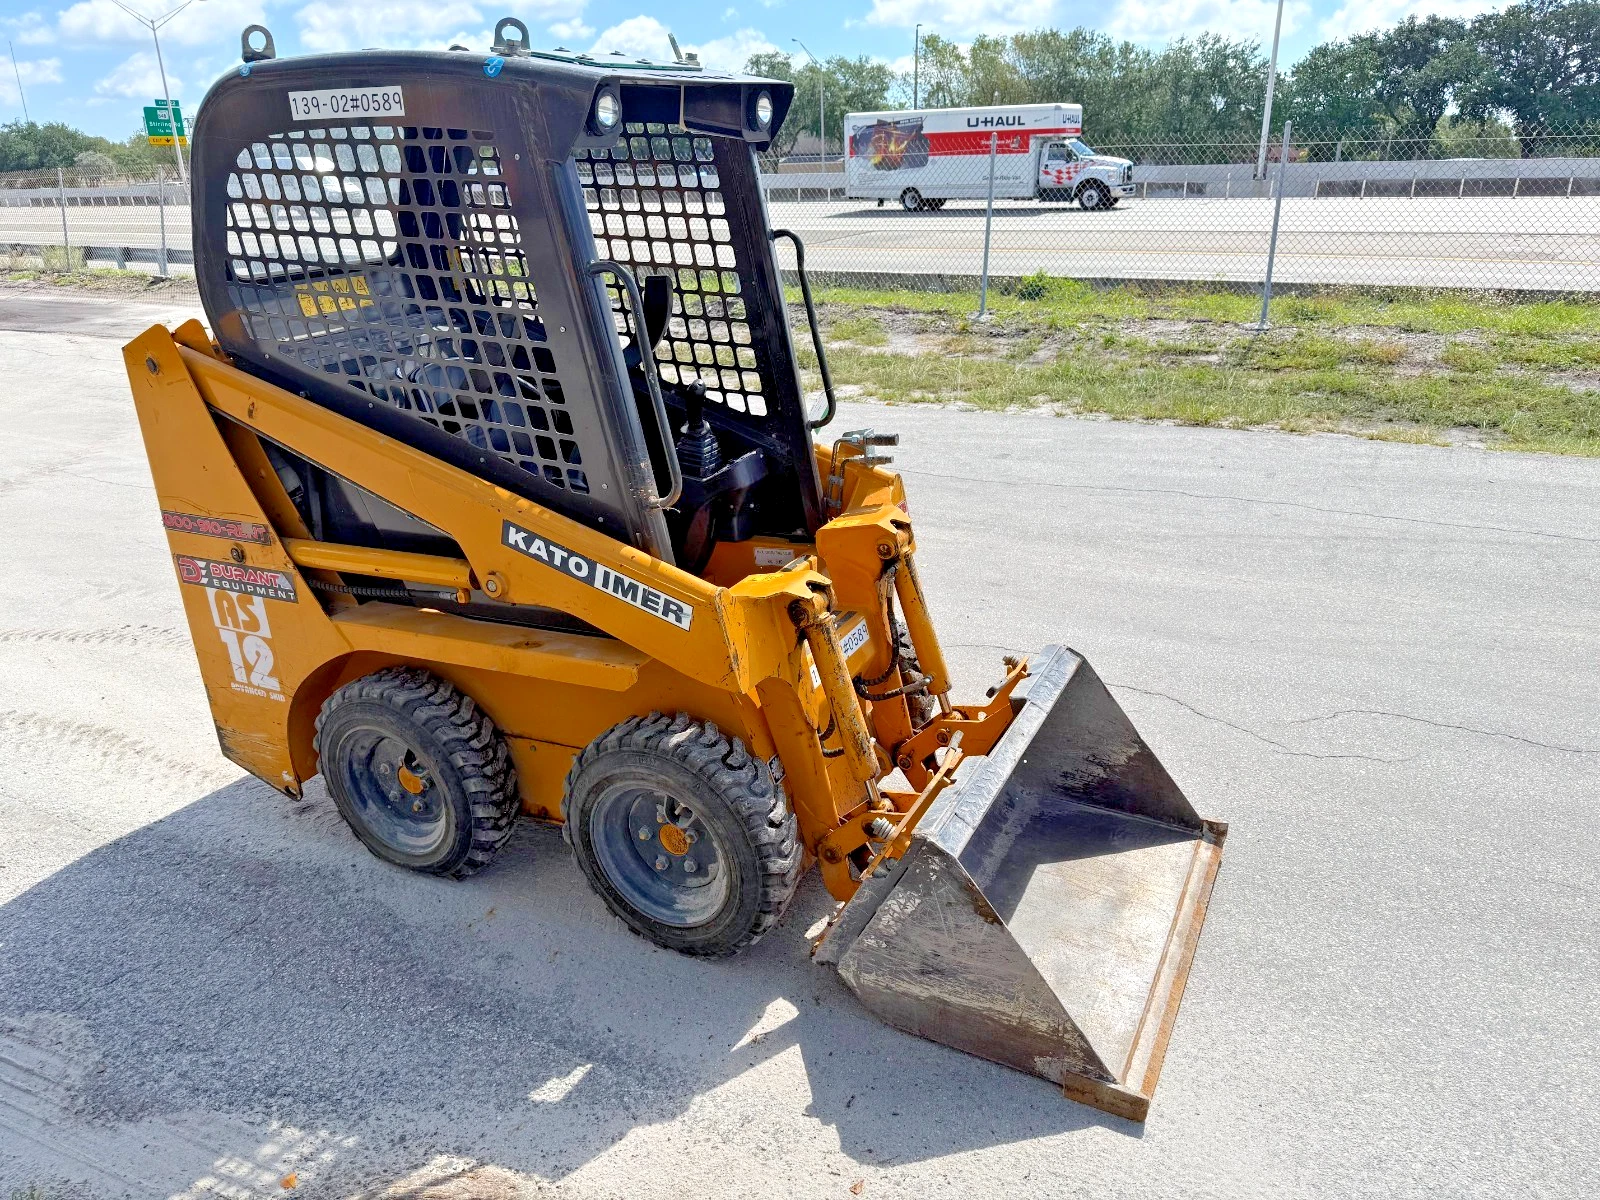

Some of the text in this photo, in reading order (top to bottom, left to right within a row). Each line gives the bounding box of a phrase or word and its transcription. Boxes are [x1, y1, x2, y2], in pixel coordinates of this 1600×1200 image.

[291, 92, 403, 115] 139-02#0589
[966, 116, 1025, 128] U-HAUL
[508, 526, 685, 625] KATO IMER
[213, 578, 296, 600] EQUIPMENT
[218, 628, 281, 692] 12
